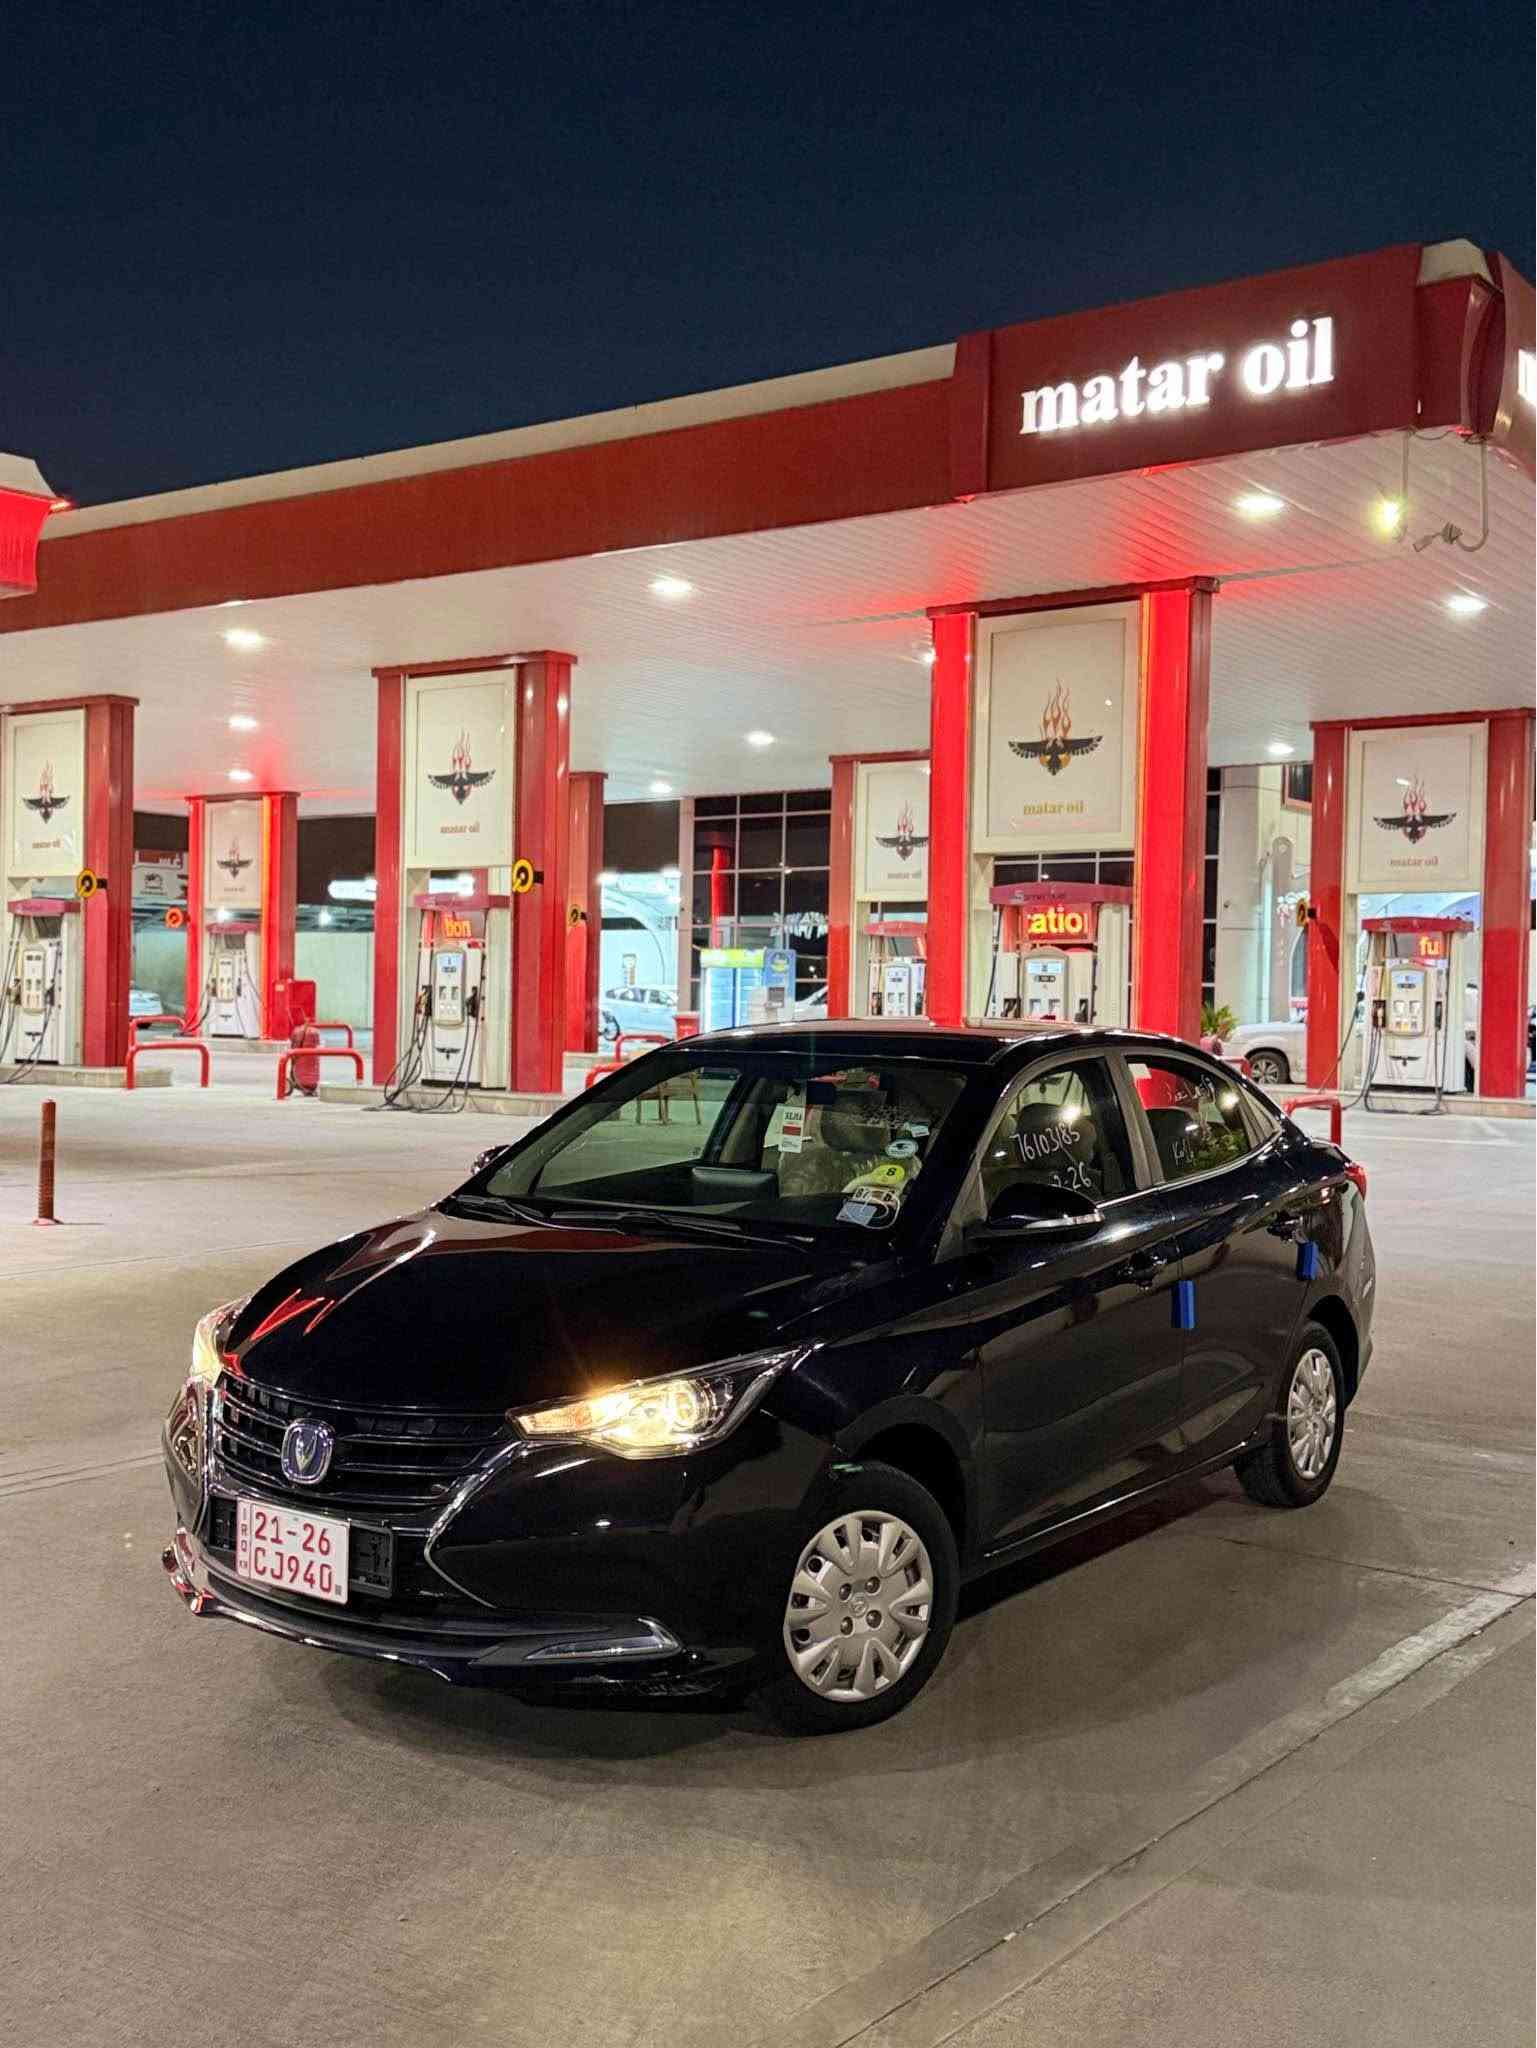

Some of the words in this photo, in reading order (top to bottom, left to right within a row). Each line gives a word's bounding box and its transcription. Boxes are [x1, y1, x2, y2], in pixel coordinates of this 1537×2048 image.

[1019, 353, 1225, 434] matar
[1242, 316, 1334, 395] oil
[1023, 801, 1063, 816] matar
[1066, 800, 1083, 814] oil
[254, 1546, 332, 1593] CJ940
